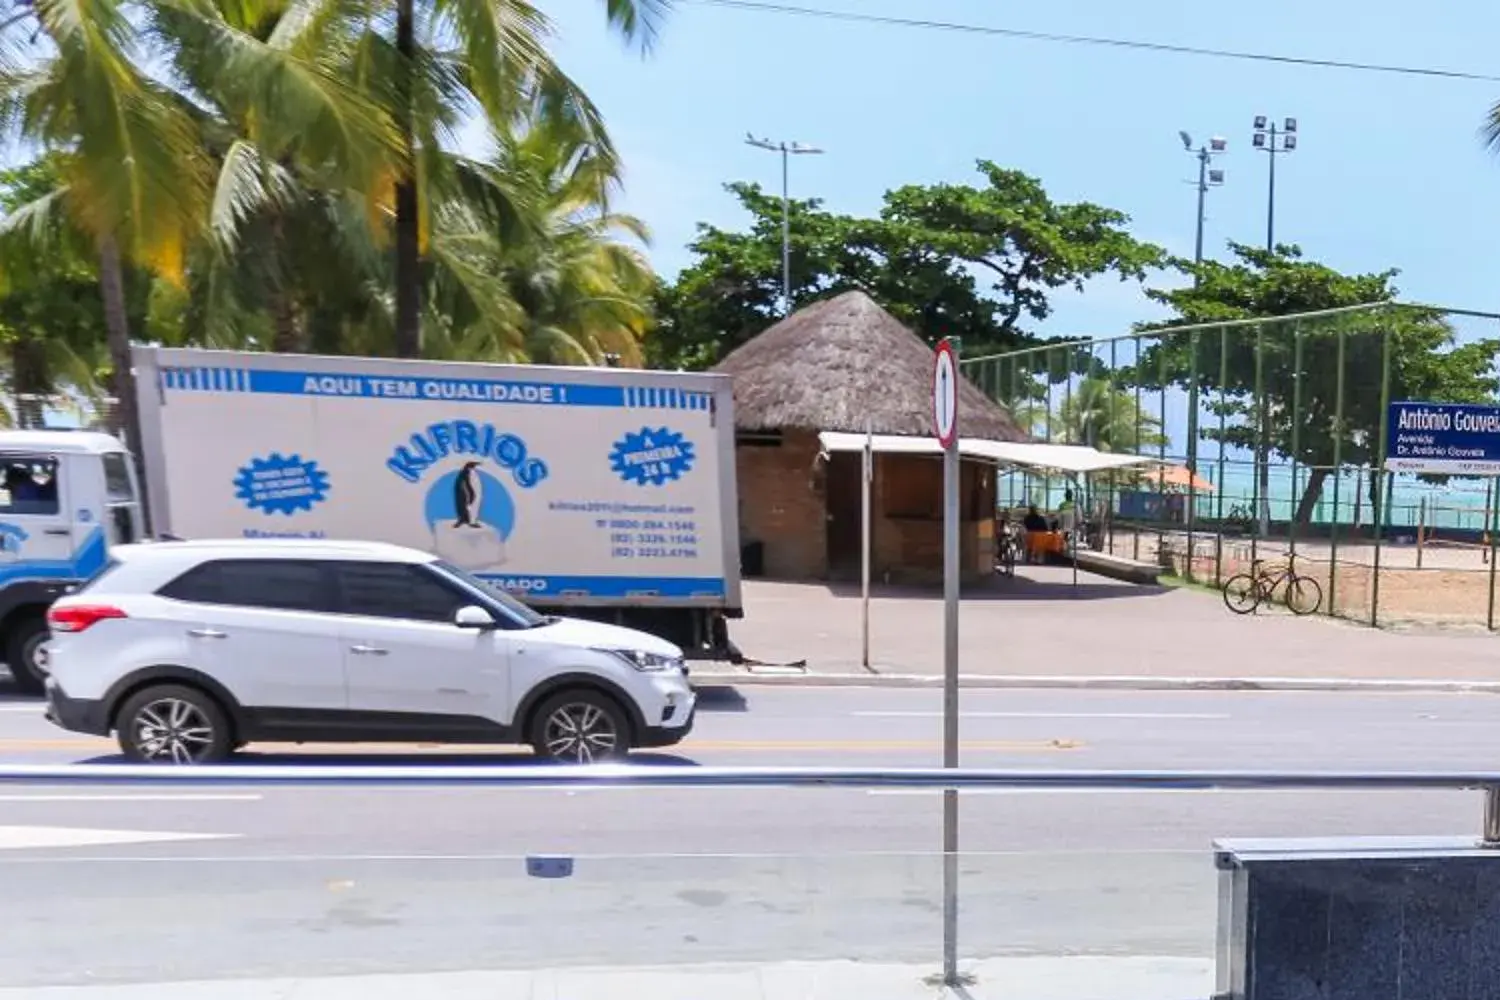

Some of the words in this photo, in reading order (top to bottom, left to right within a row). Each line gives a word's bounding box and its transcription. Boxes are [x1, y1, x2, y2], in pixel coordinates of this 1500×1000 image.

[303, 375, 362, 395] AQUI
[367, 378, 417, 397] TEM
[423, 380, 554, 403] QUALIDADE
[1398, 406, 1450, 430] Antônio
[386, 419, 549, 488] KIFRIOS
